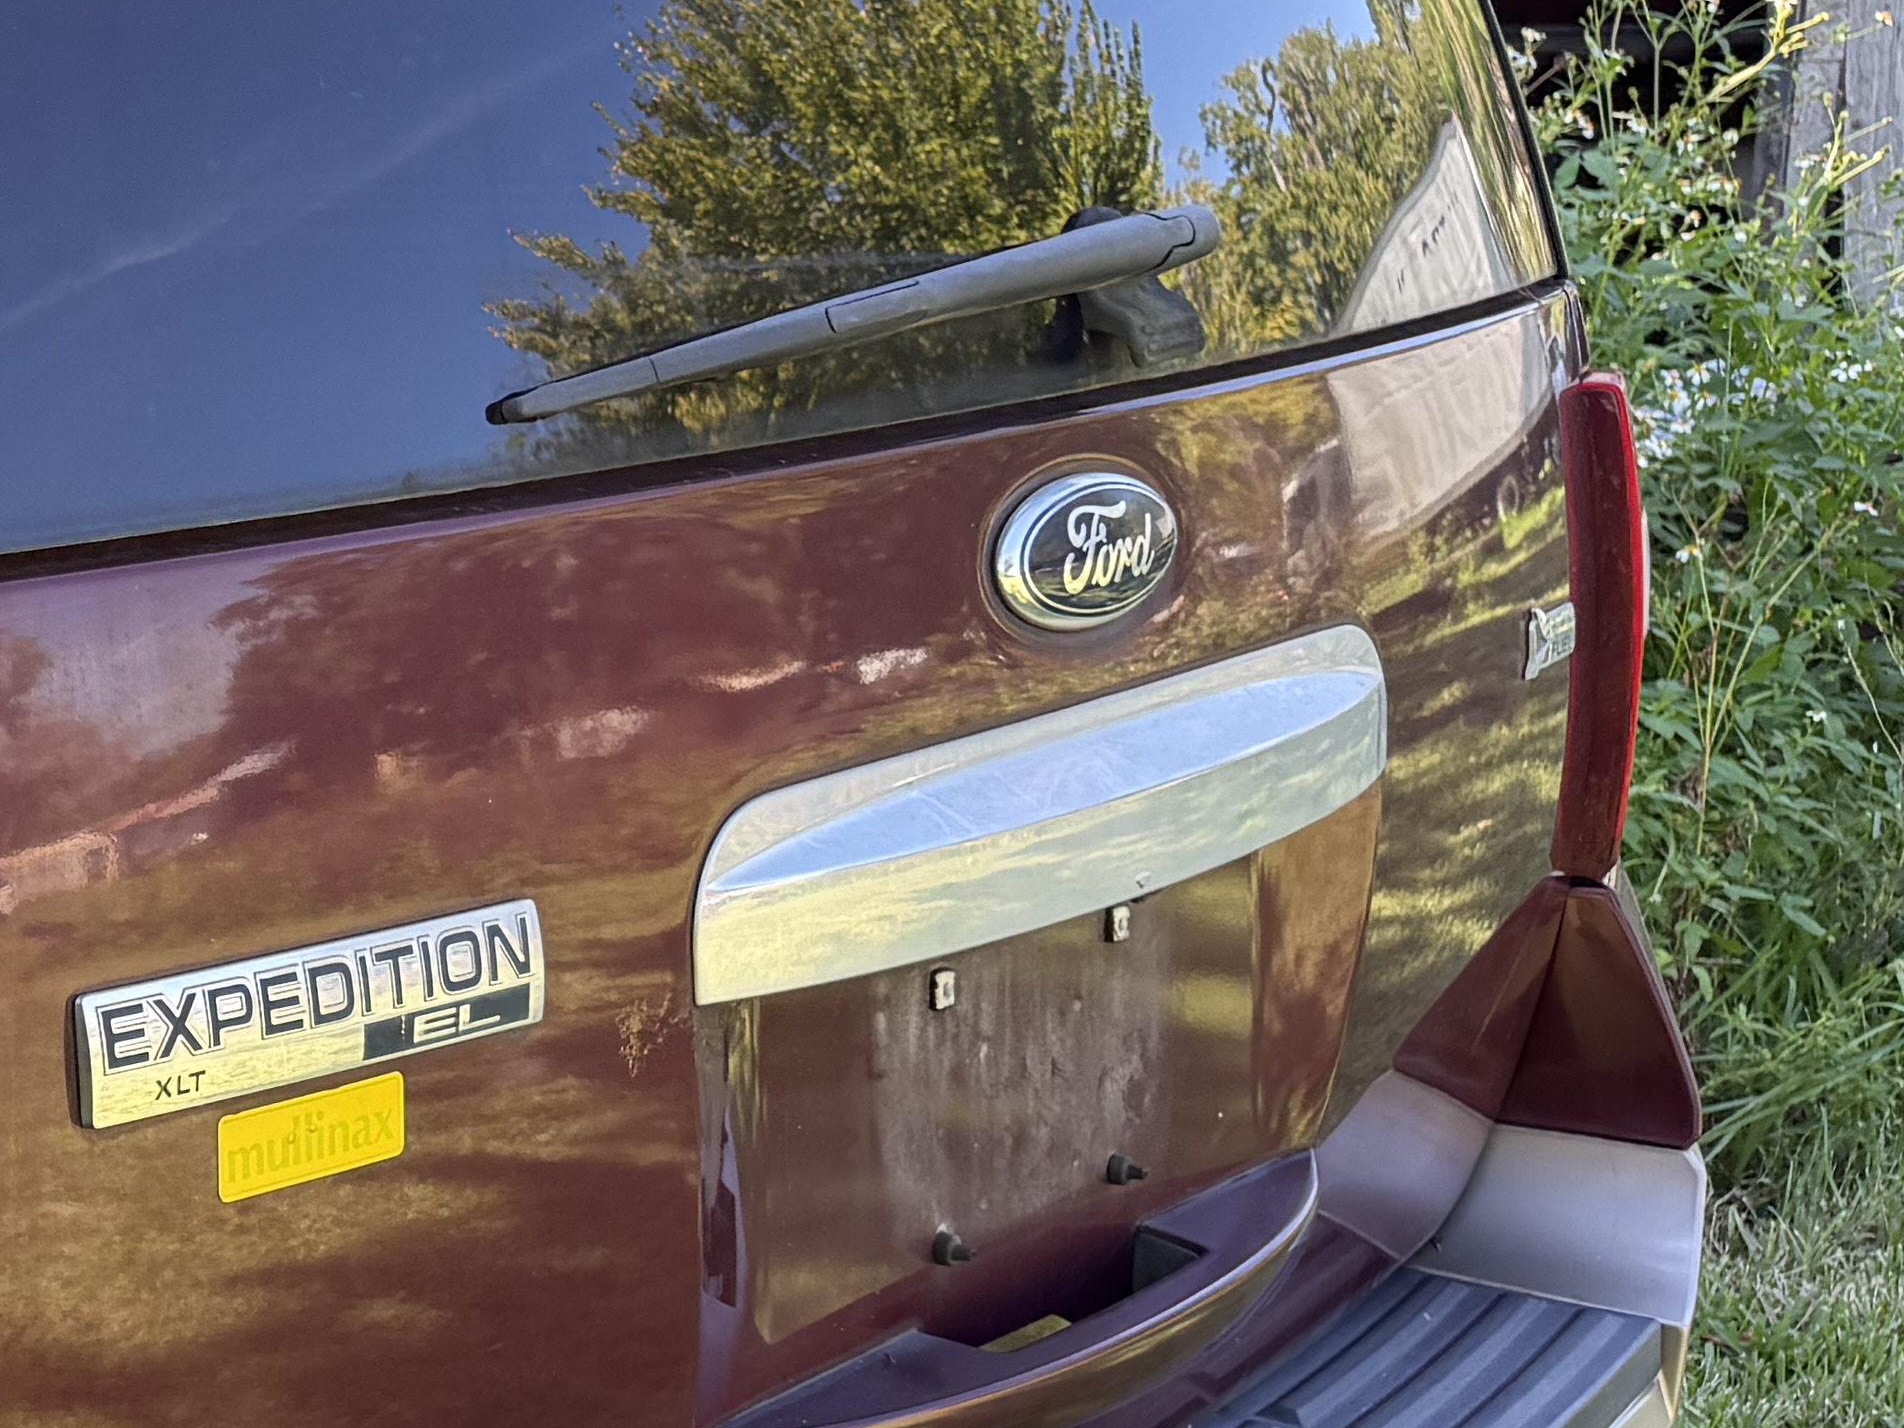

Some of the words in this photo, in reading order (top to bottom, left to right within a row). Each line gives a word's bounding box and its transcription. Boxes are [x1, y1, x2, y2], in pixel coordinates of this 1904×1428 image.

[1063, 499, 1155, 594] Ford
[96, 912, 533, 1074] EXPEDITION
[413, 1003, 501, 1044] EL
[154, 1070, 206, 1101] XLT
[227, 1109, 394, 1182] mullinax
